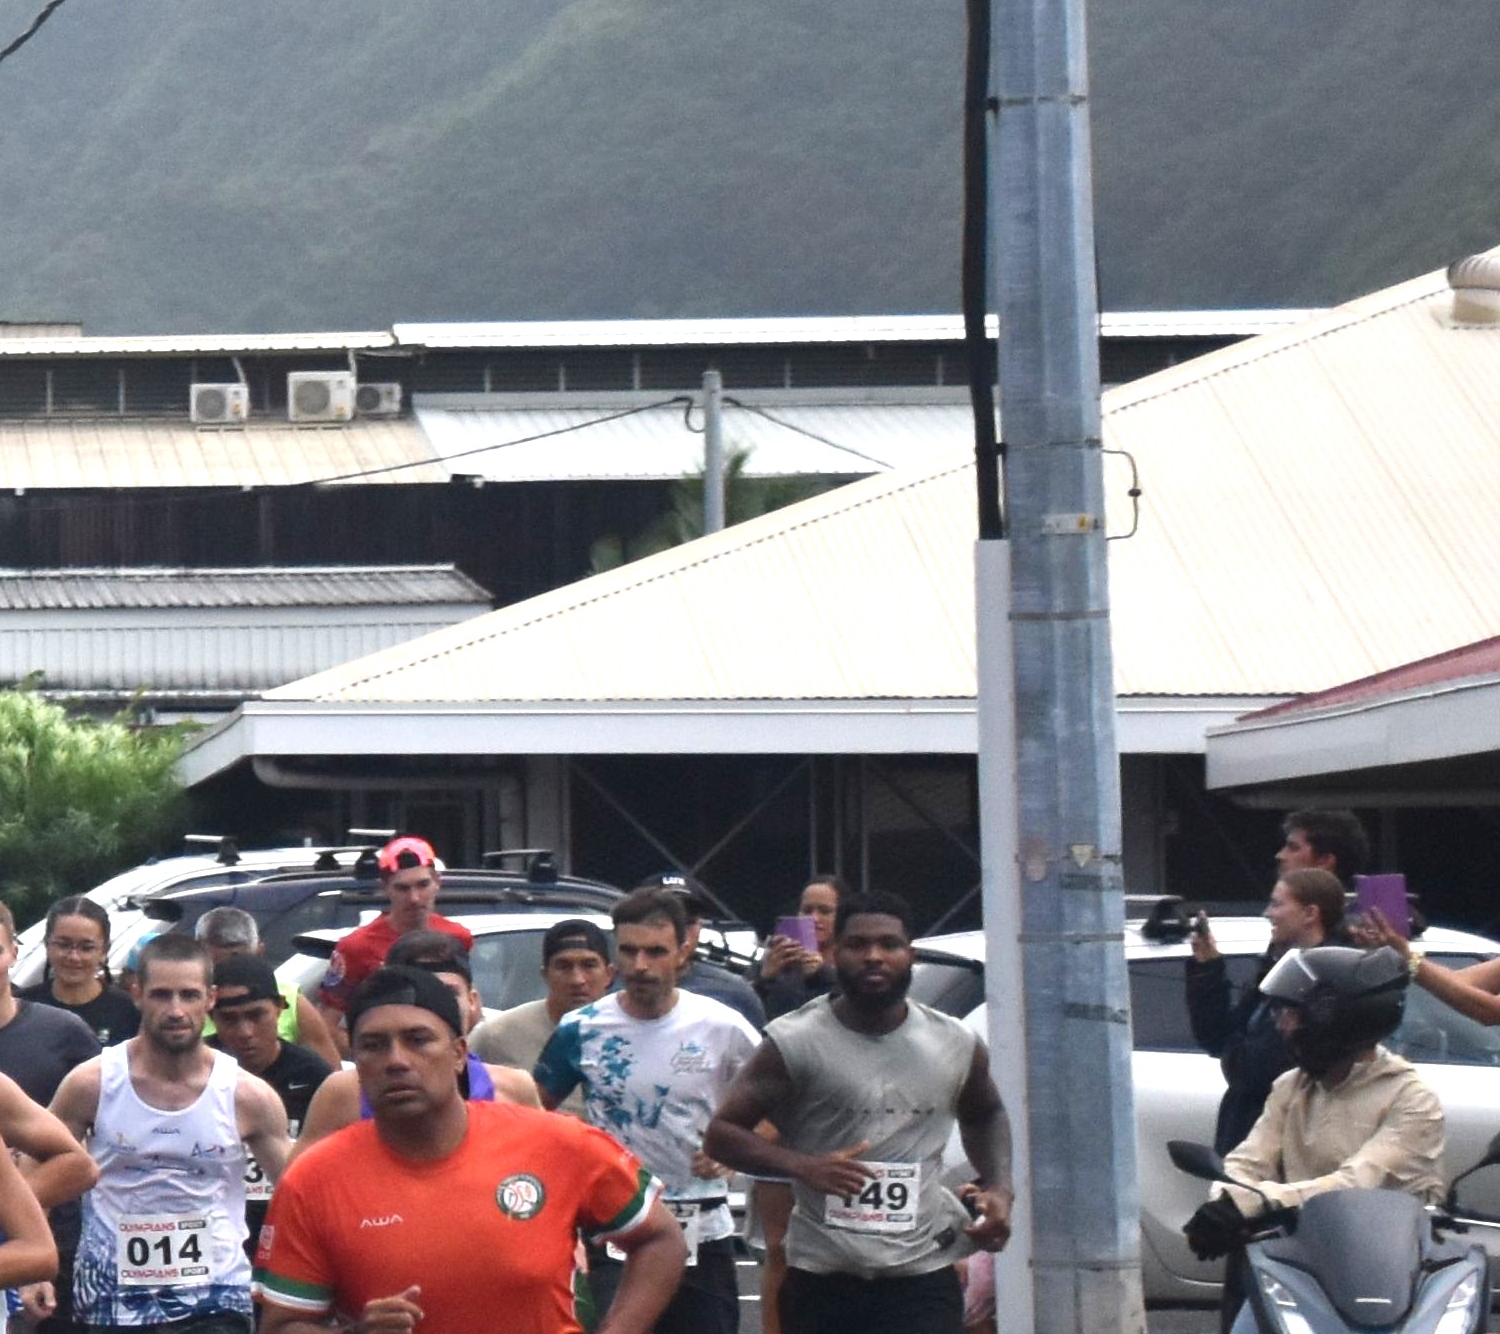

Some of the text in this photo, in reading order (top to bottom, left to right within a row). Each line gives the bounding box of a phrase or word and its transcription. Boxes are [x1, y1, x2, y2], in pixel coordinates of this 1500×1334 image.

[119, 1222, 176, 1232] OLYMPIANS
[127, 1233, 202, 1266] 014
[121, 1269, 179, 1279] OLYMPIANS
